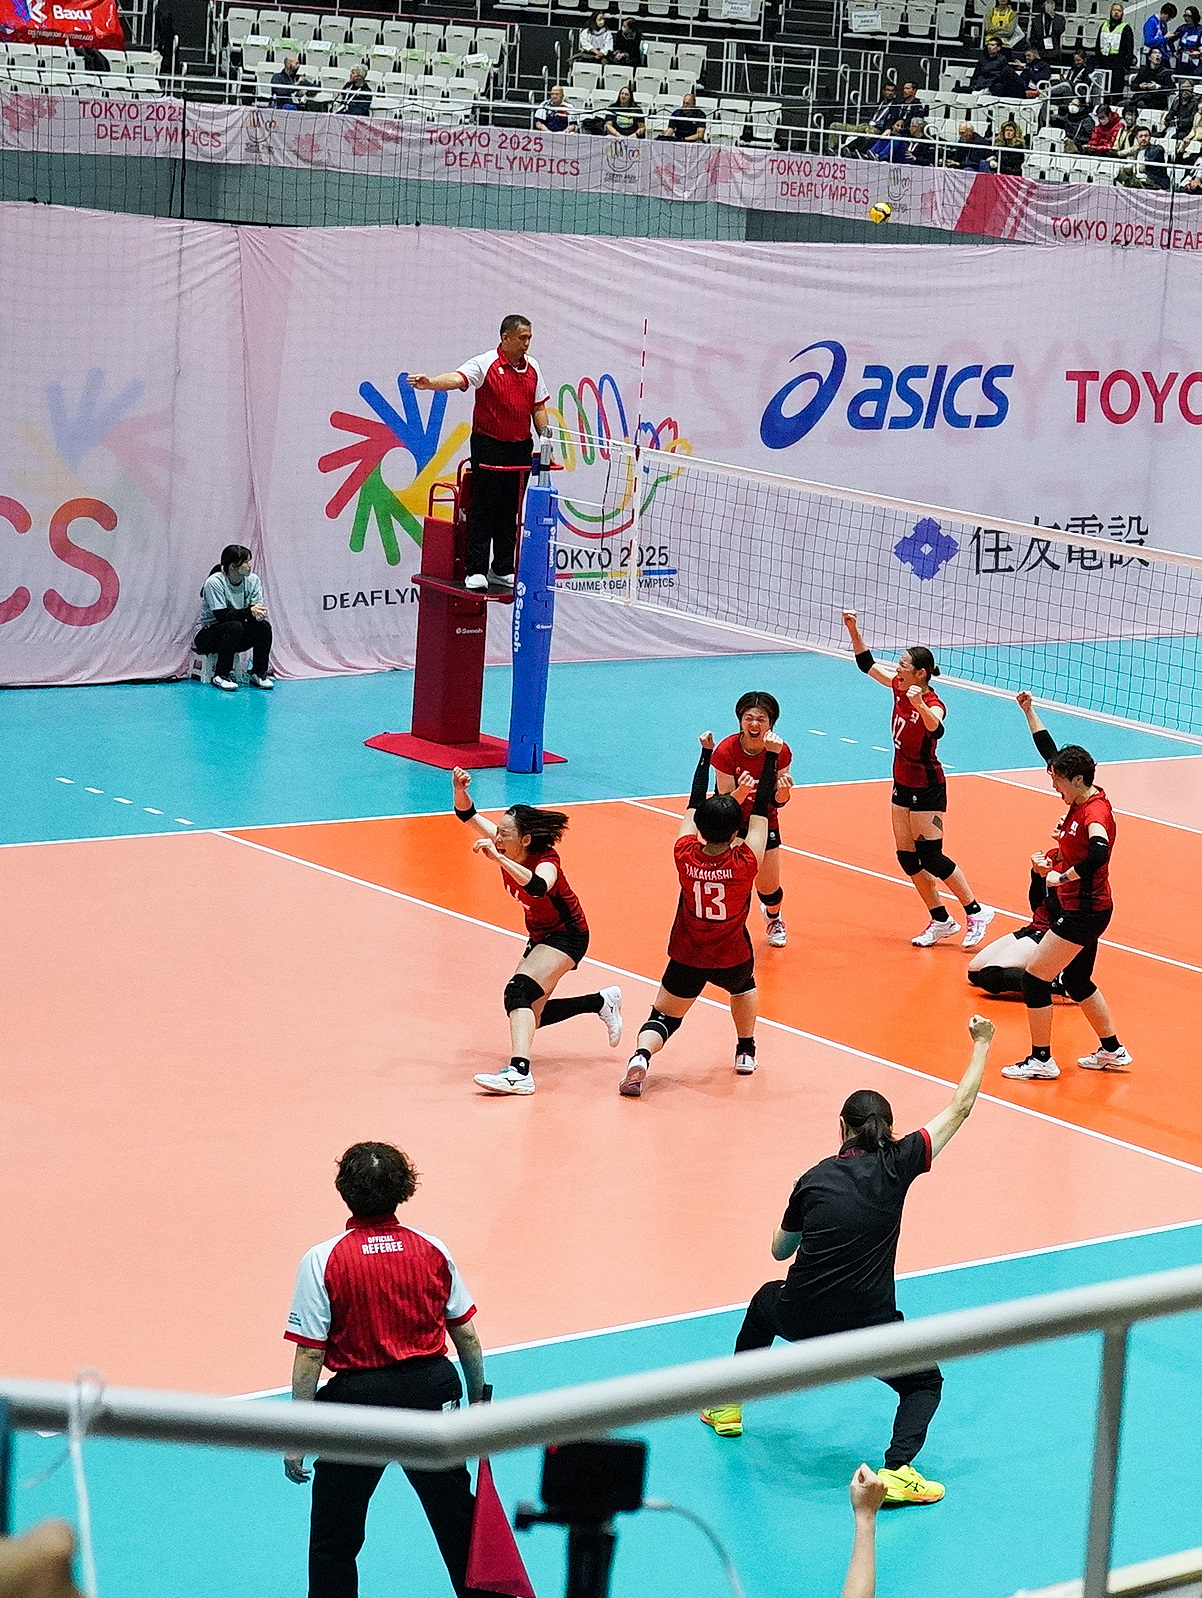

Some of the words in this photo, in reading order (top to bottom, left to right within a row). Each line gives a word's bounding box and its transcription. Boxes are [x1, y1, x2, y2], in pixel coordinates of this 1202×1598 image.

[78, 101, 139, 120] TOKYO
[96, 123, 222, 149] DEAFLYMPICS
[426, 129, 490, 148] TOKYO
[497, 133, 544, 152] 2025
[444, 151, 580, 176] DEAFLYMPICS
[769, 159, 812, 178] TOKYO
[816, 161, 847, 180] 2025
[780, 180, 870, 205] DEAFLYMPICS
[1051, 216, 1107, 241] TOKYO
[1113, 222, 1155, 246] 2025
[968, 513, 1151, 576] 住友電設
[556, 547, 612, 569] OKYO
[565, 581, 607, 591] SUMMER
[608, 578, 675, 590] DEAYMPICS
[513, 597, 524, 653] Senoh
[684, 862, 733, 881] TAKAHASHI
[693, 880, 727, 921] 13
[361, 1241, 405, 1255] REFEREE
[367, 1234, 395, 1244] OFFICIAL
